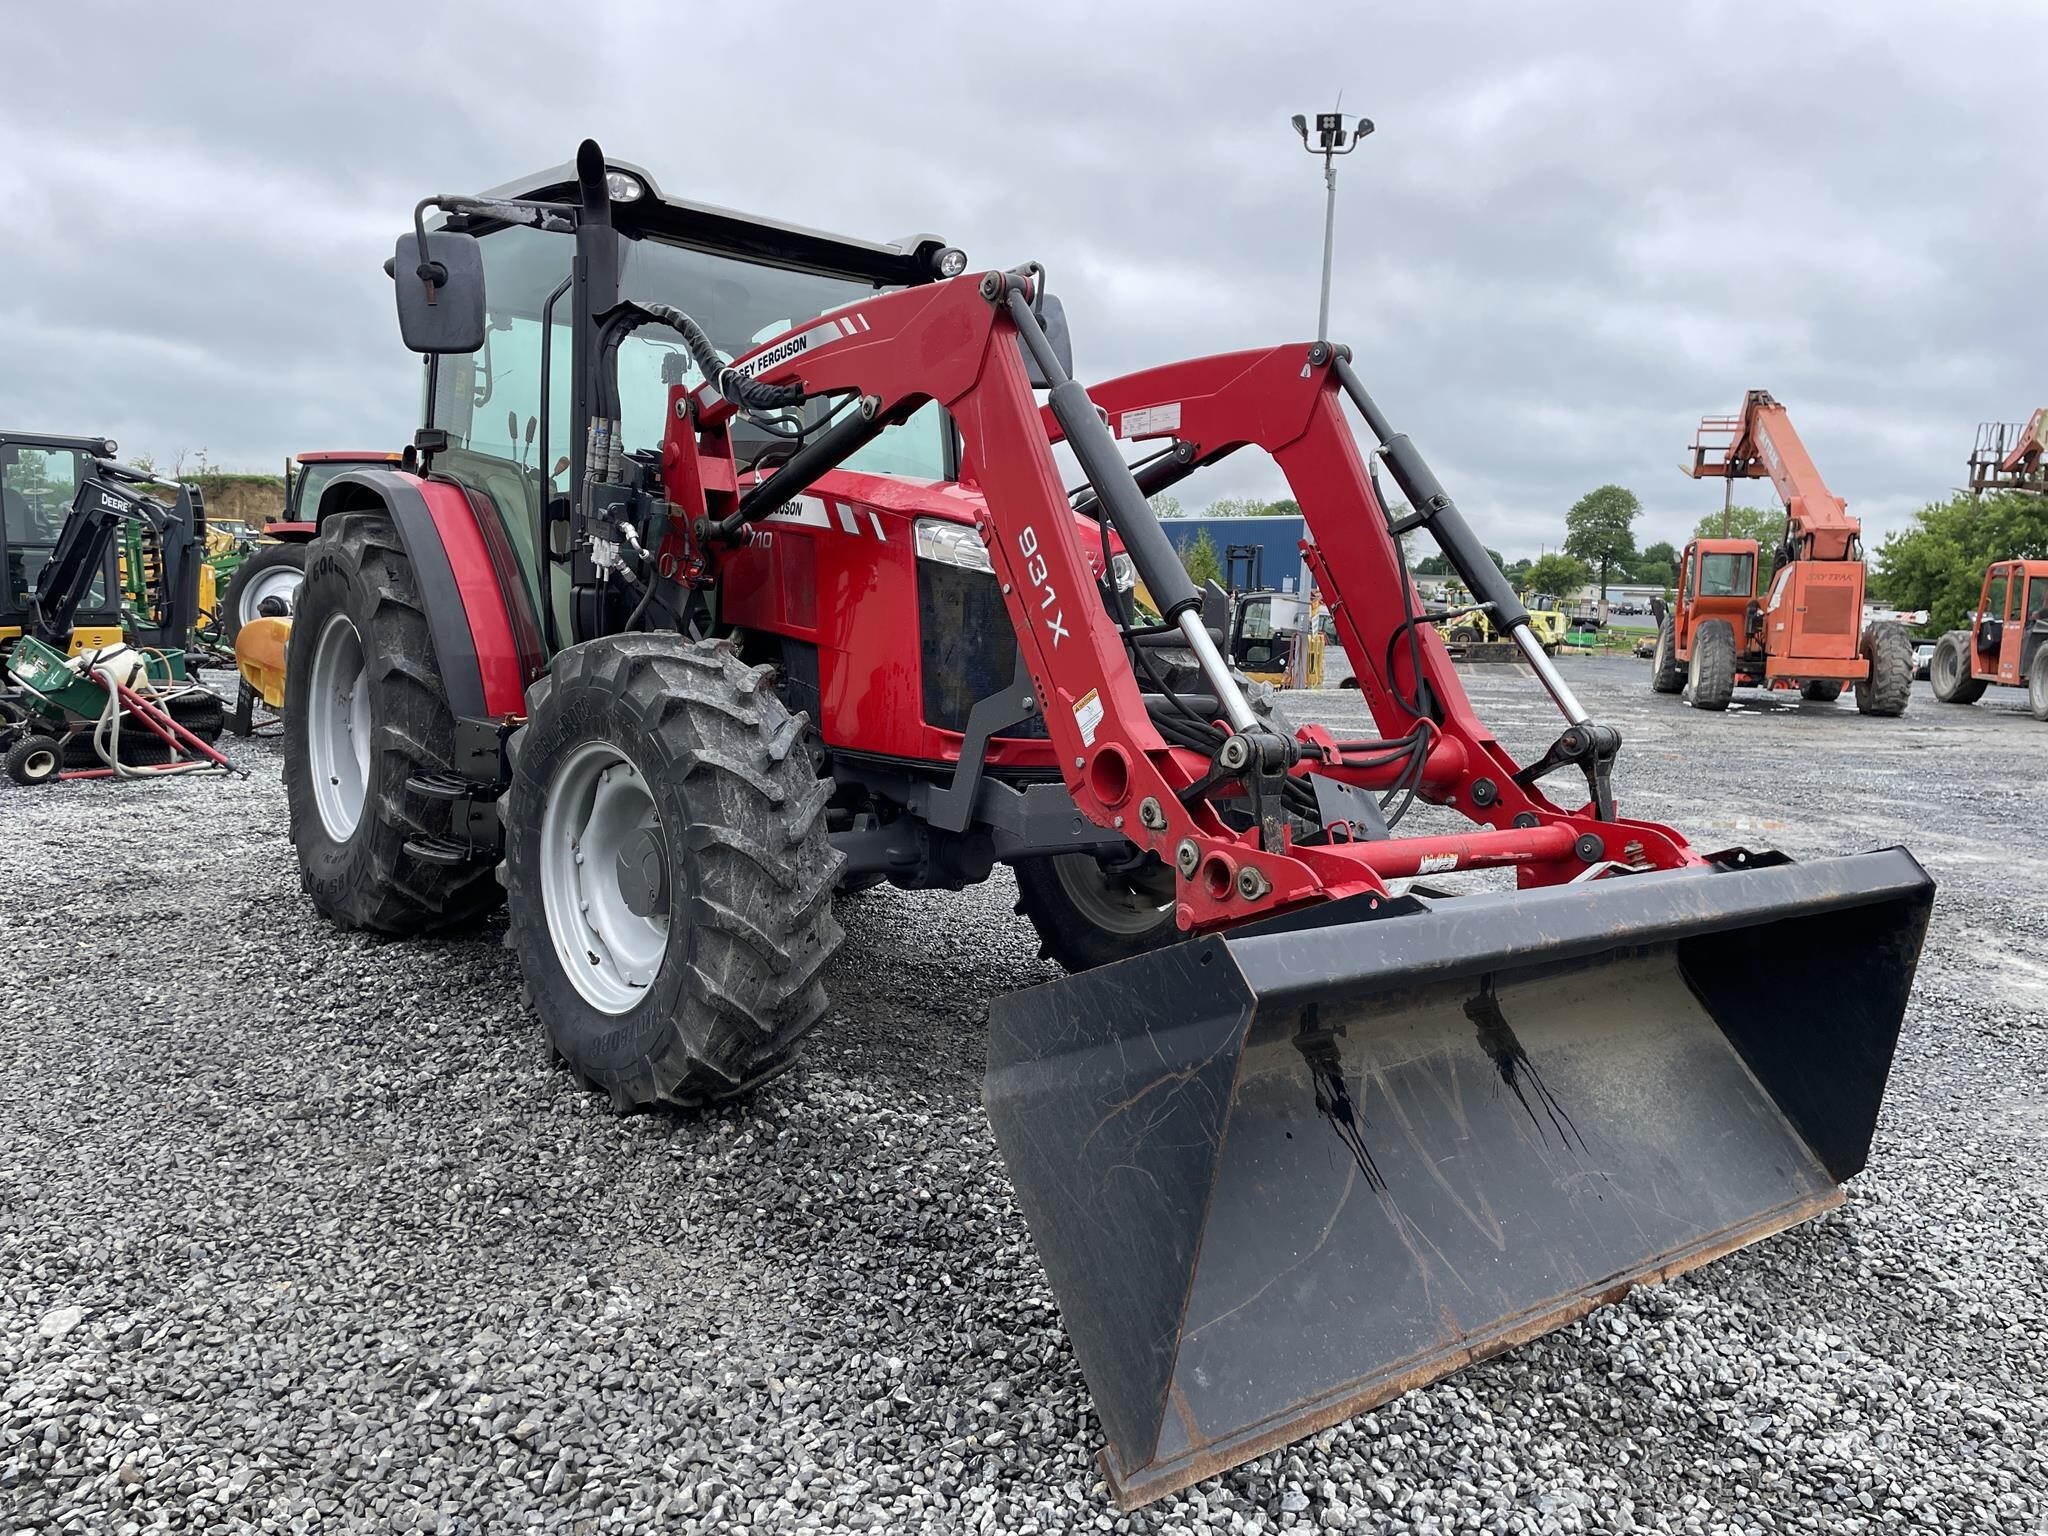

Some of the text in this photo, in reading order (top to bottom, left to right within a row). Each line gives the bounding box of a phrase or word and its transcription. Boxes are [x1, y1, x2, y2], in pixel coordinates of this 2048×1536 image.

[758, 335, 807, 372] FERGUSON
[101, 492, 129, 513] DEERE
[748, 530, 773, 549] 710
[1018, 525, 1071, 651] 931X
